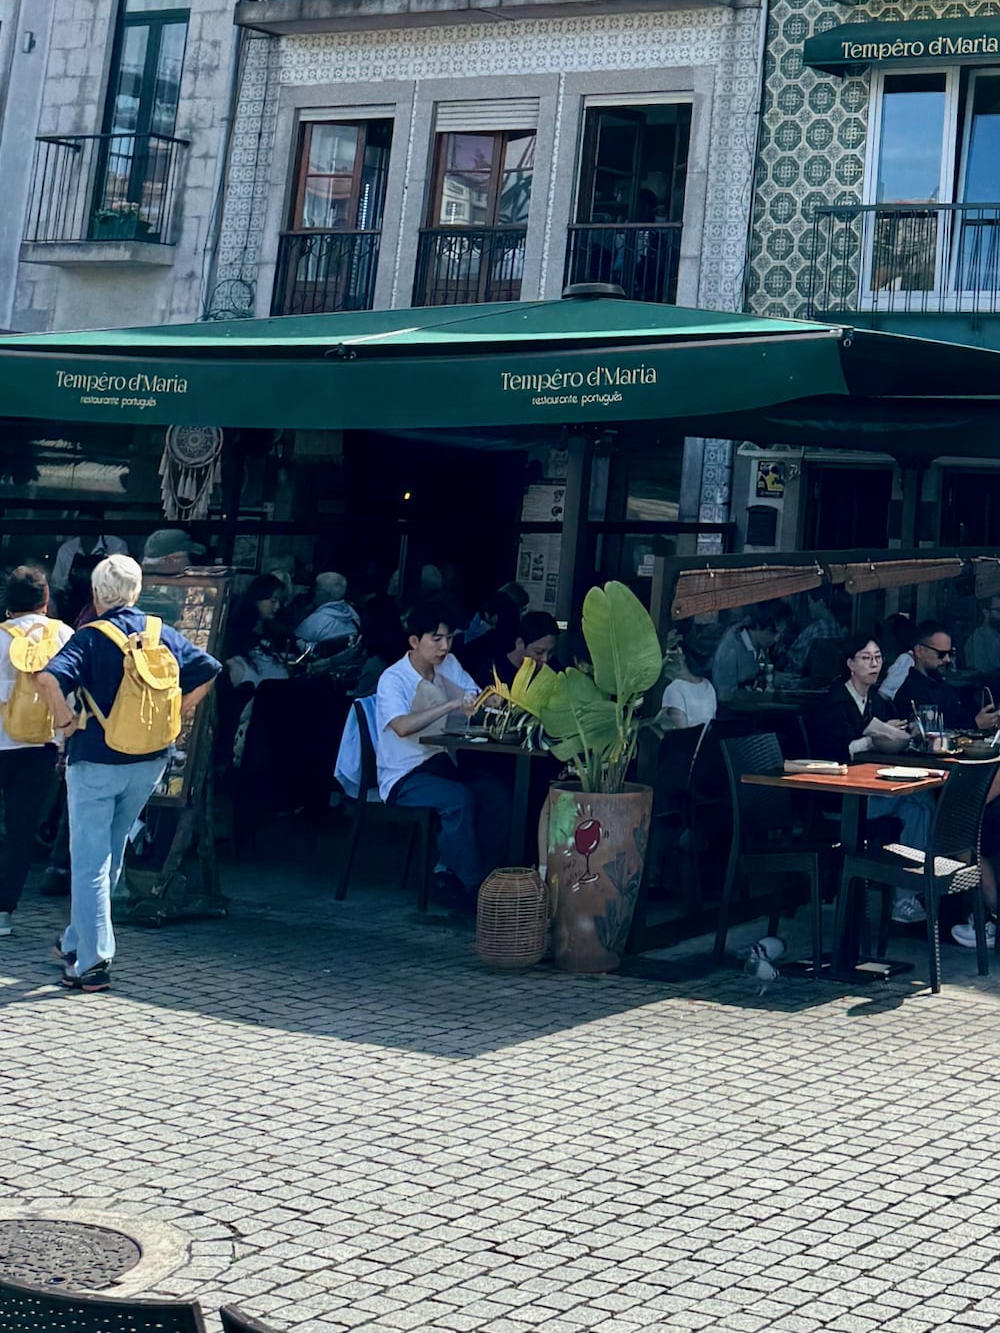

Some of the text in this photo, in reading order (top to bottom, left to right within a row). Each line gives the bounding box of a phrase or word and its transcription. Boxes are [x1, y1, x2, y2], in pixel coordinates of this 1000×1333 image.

[841, 34, 999, 60] Tempêro d'Maria
[56, 370, 188, 393] Tempêro d'Maria
[501, 364, 657, 392] Tempêro d'Maria
[80, 396, 157, 409] restaurante português
[532, 391, 622, 406] restaurante português
